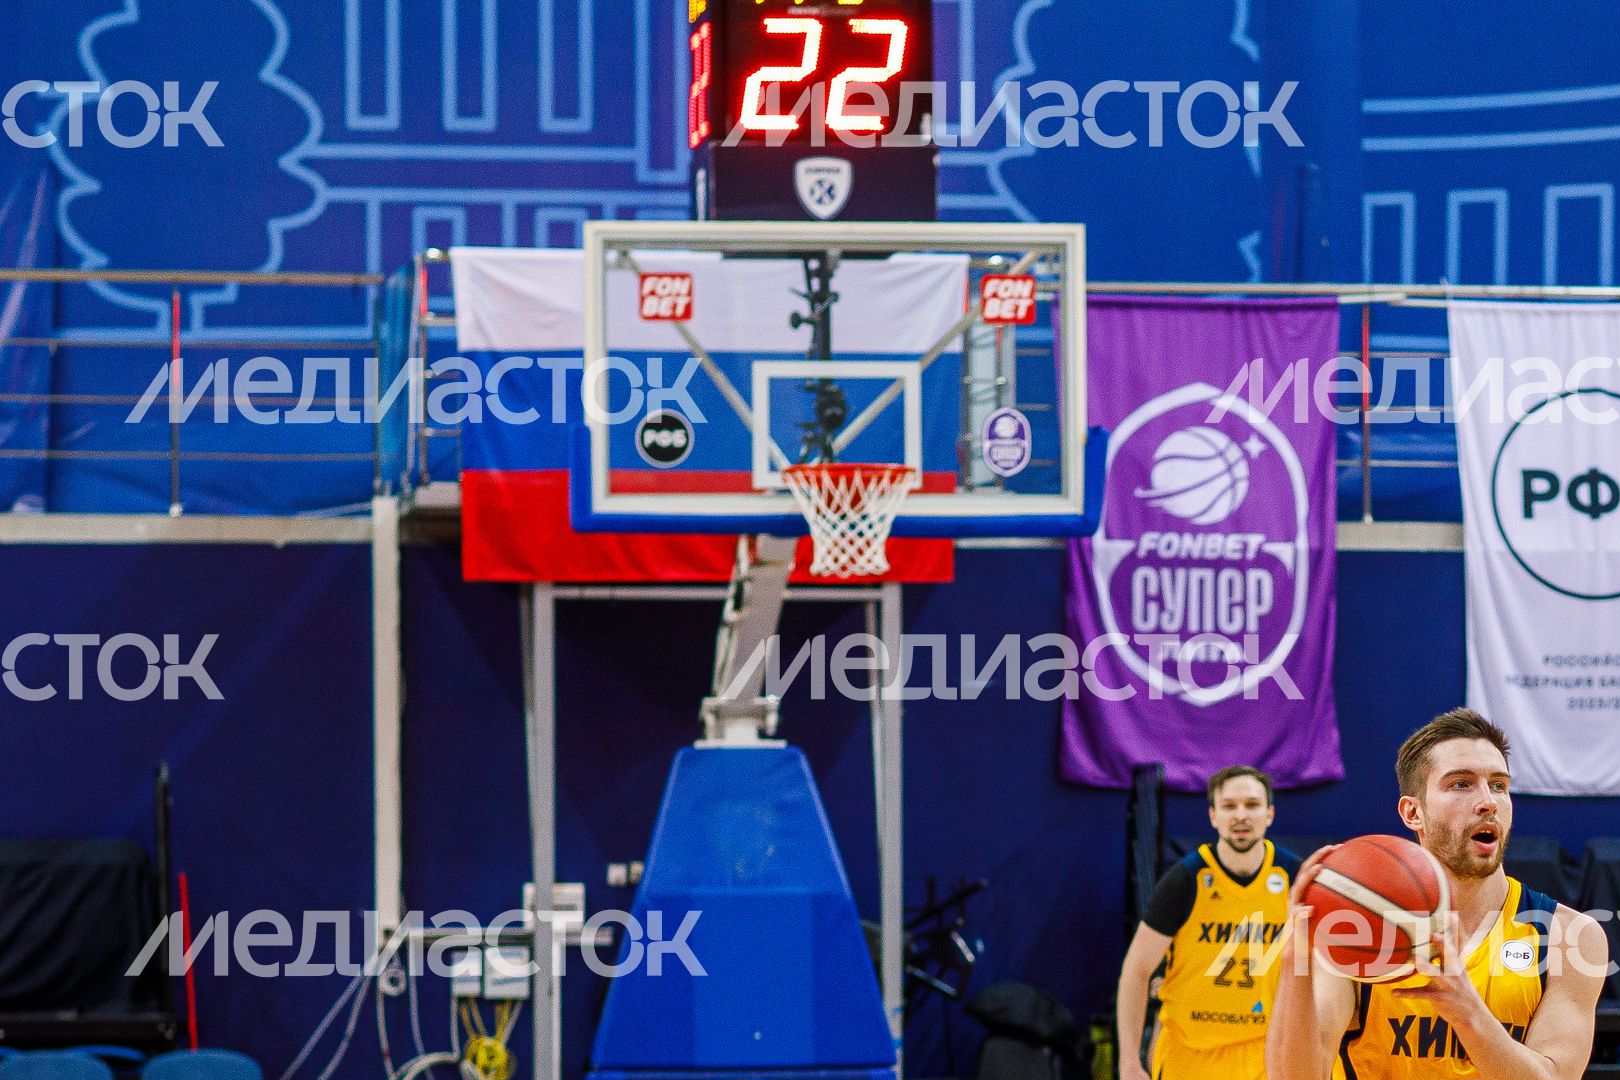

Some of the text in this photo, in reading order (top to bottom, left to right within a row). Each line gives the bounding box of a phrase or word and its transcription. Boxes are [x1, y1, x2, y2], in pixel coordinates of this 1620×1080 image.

[740, 18, 908, 130] 22
[643, 277, 691, 295] FON
[984, 278, 1033, 297] FON
[643, 297, 691, 316] BET
[984, 298, 1034, 319] BET
[1136, 531, 1266, 560] FONBET
[1131, 565, 1274, 635] СУПЕР
[1505, 950, 1530, 960] РФБ
[1214, 957, 1257, 988] 23
